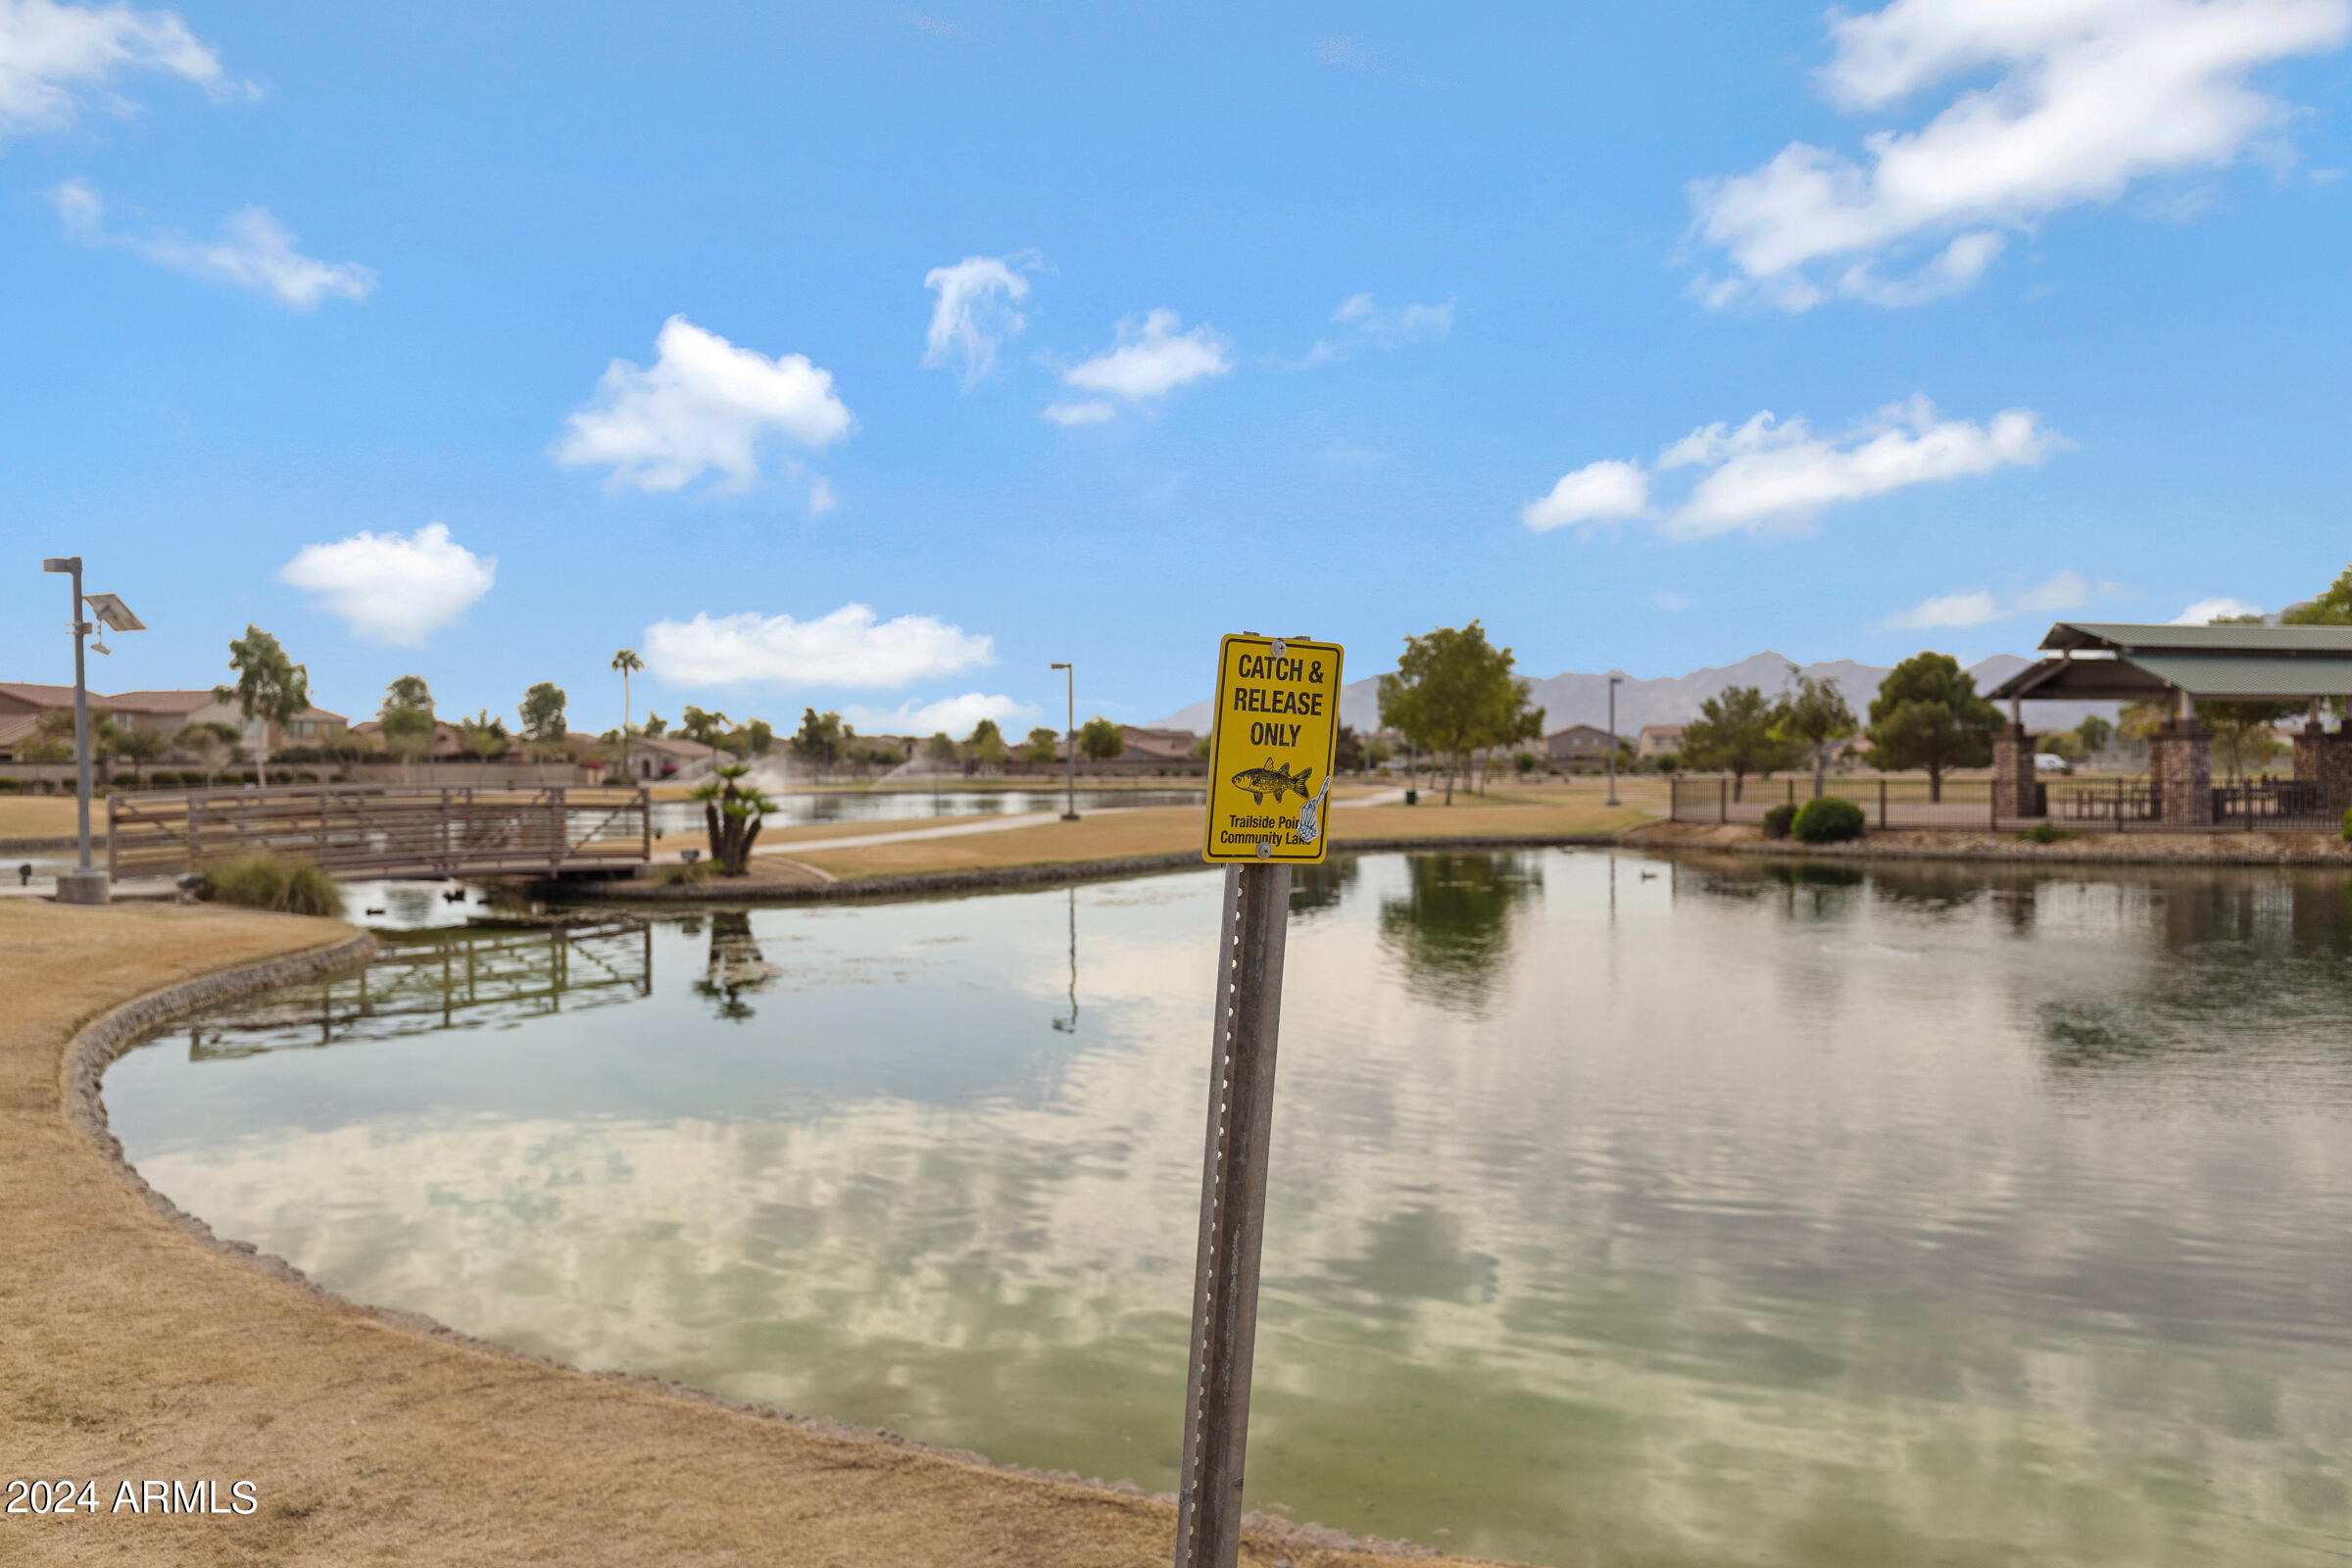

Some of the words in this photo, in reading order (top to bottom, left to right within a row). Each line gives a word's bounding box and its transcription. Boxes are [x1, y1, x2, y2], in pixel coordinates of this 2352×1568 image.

[1239, 654, 1303, 682] CATCH
[1308, 661, 1324, 684] &
[1234, 687, 1323, 716] RELEASE
[1250, 721, 1301, 748] ONLY
[1229, 814, 1276, 829] Trailside
[1220, 830, 1283, 848] Community
